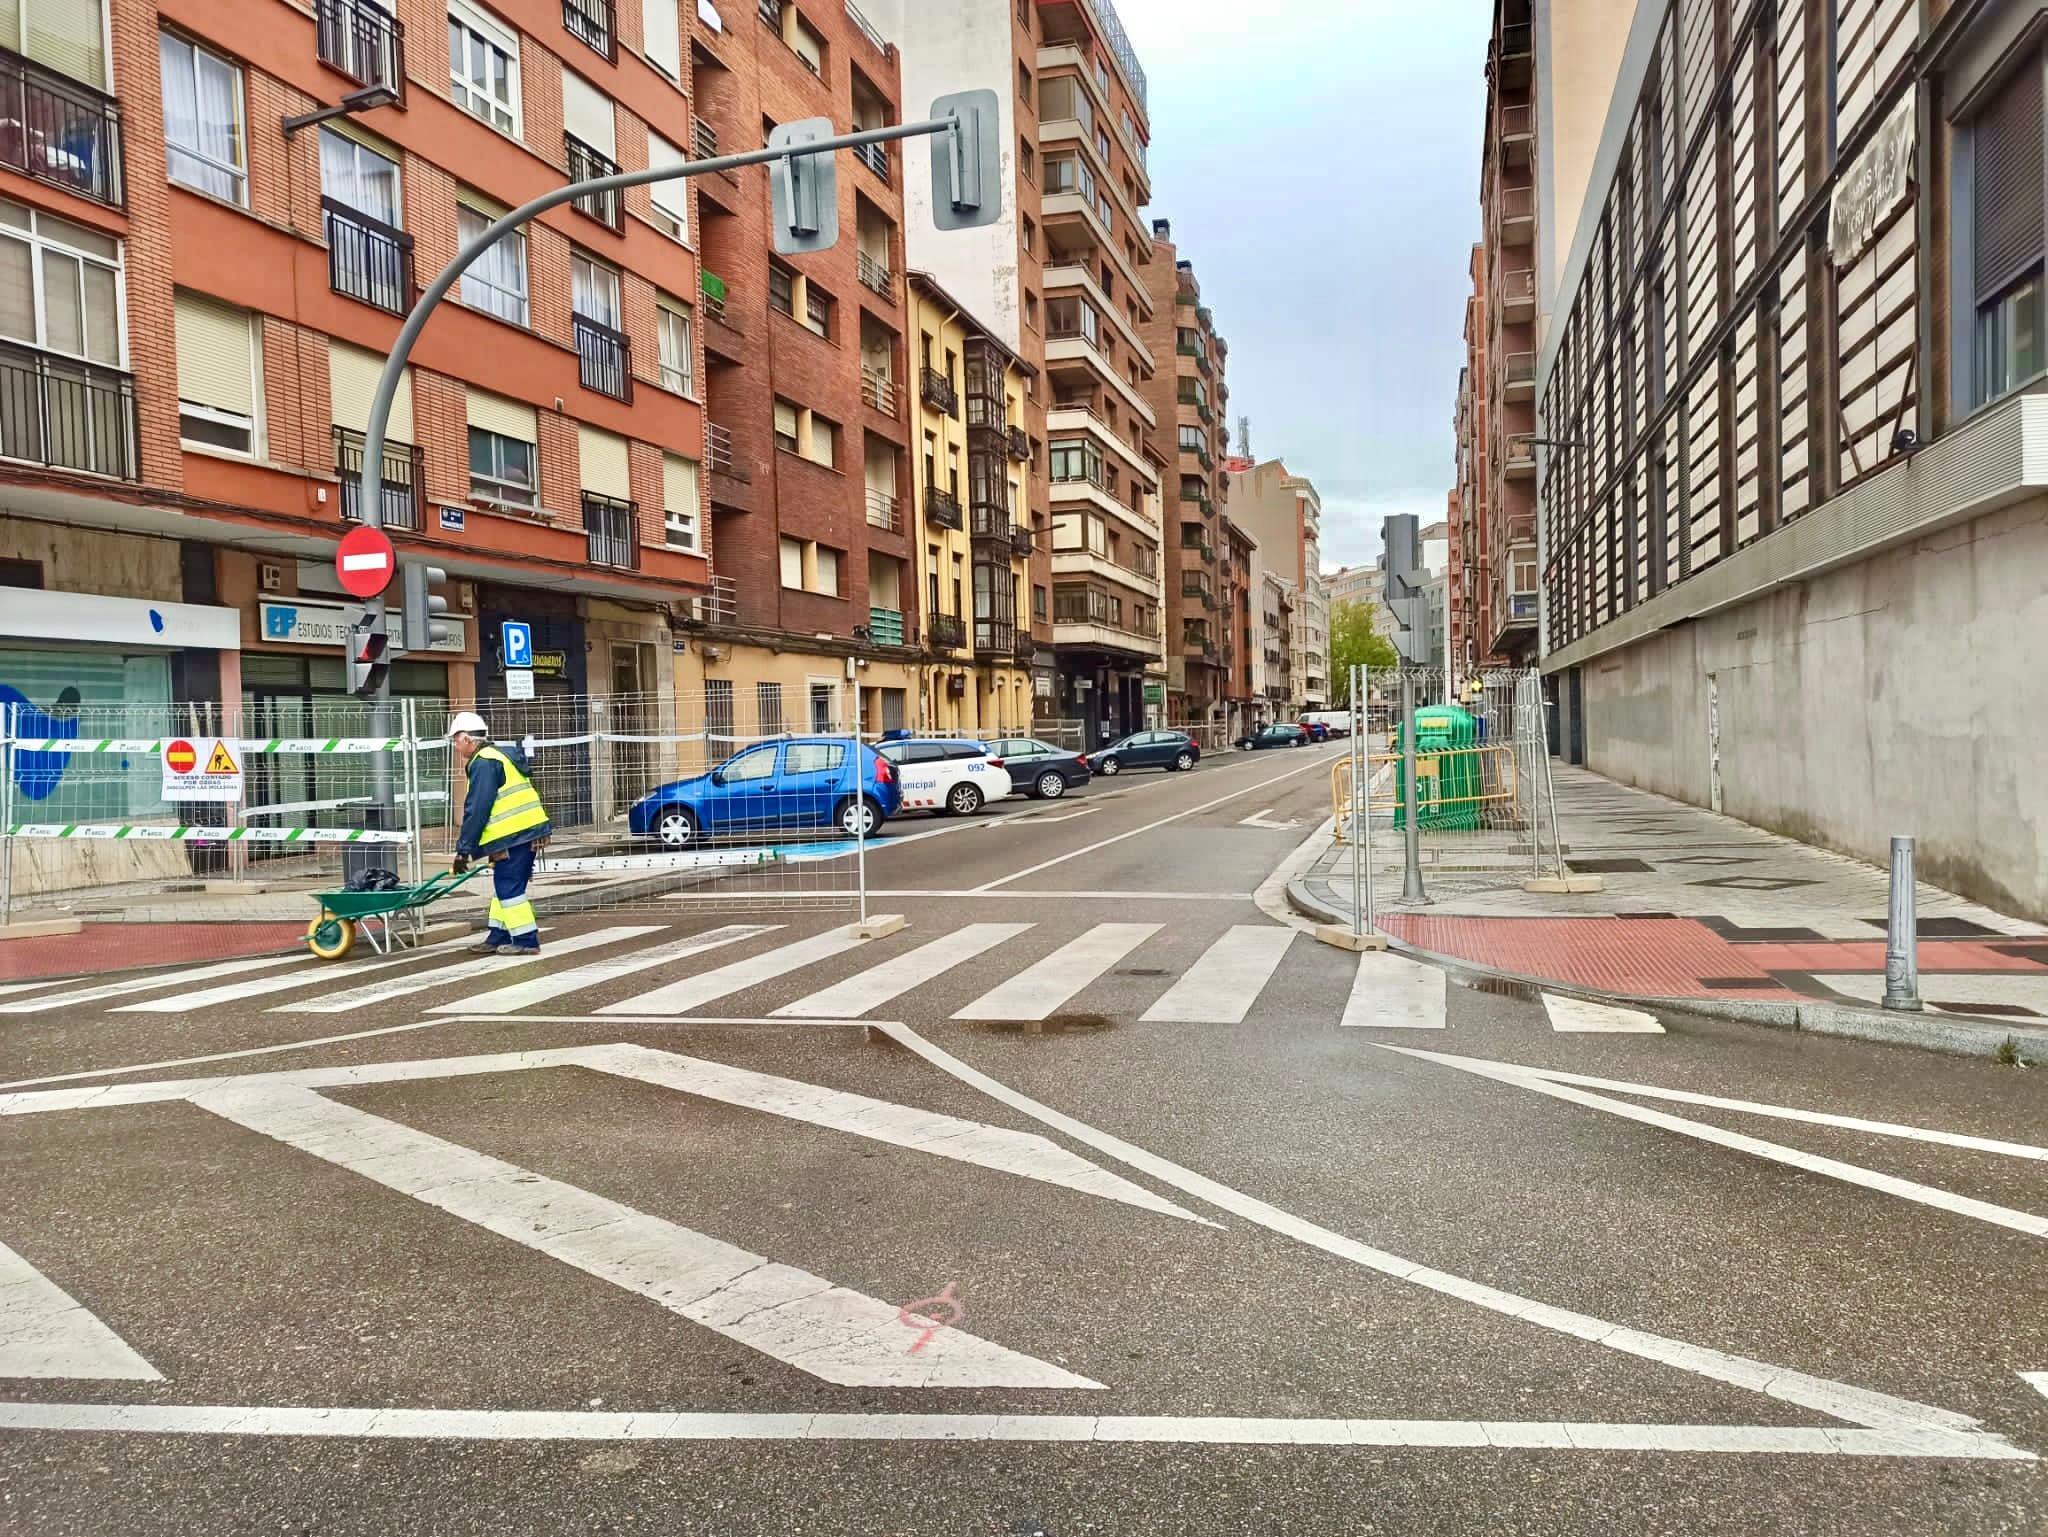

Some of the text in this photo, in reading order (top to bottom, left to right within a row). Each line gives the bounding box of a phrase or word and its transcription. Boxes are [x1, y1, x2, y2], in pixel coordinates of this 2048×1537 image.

[298, 622, 333, 639] ESTUDIOS
[509, 628, 525, 661] P
[968, 763, 985, 773] 092
[901, 780, 936, 791] unicipal
